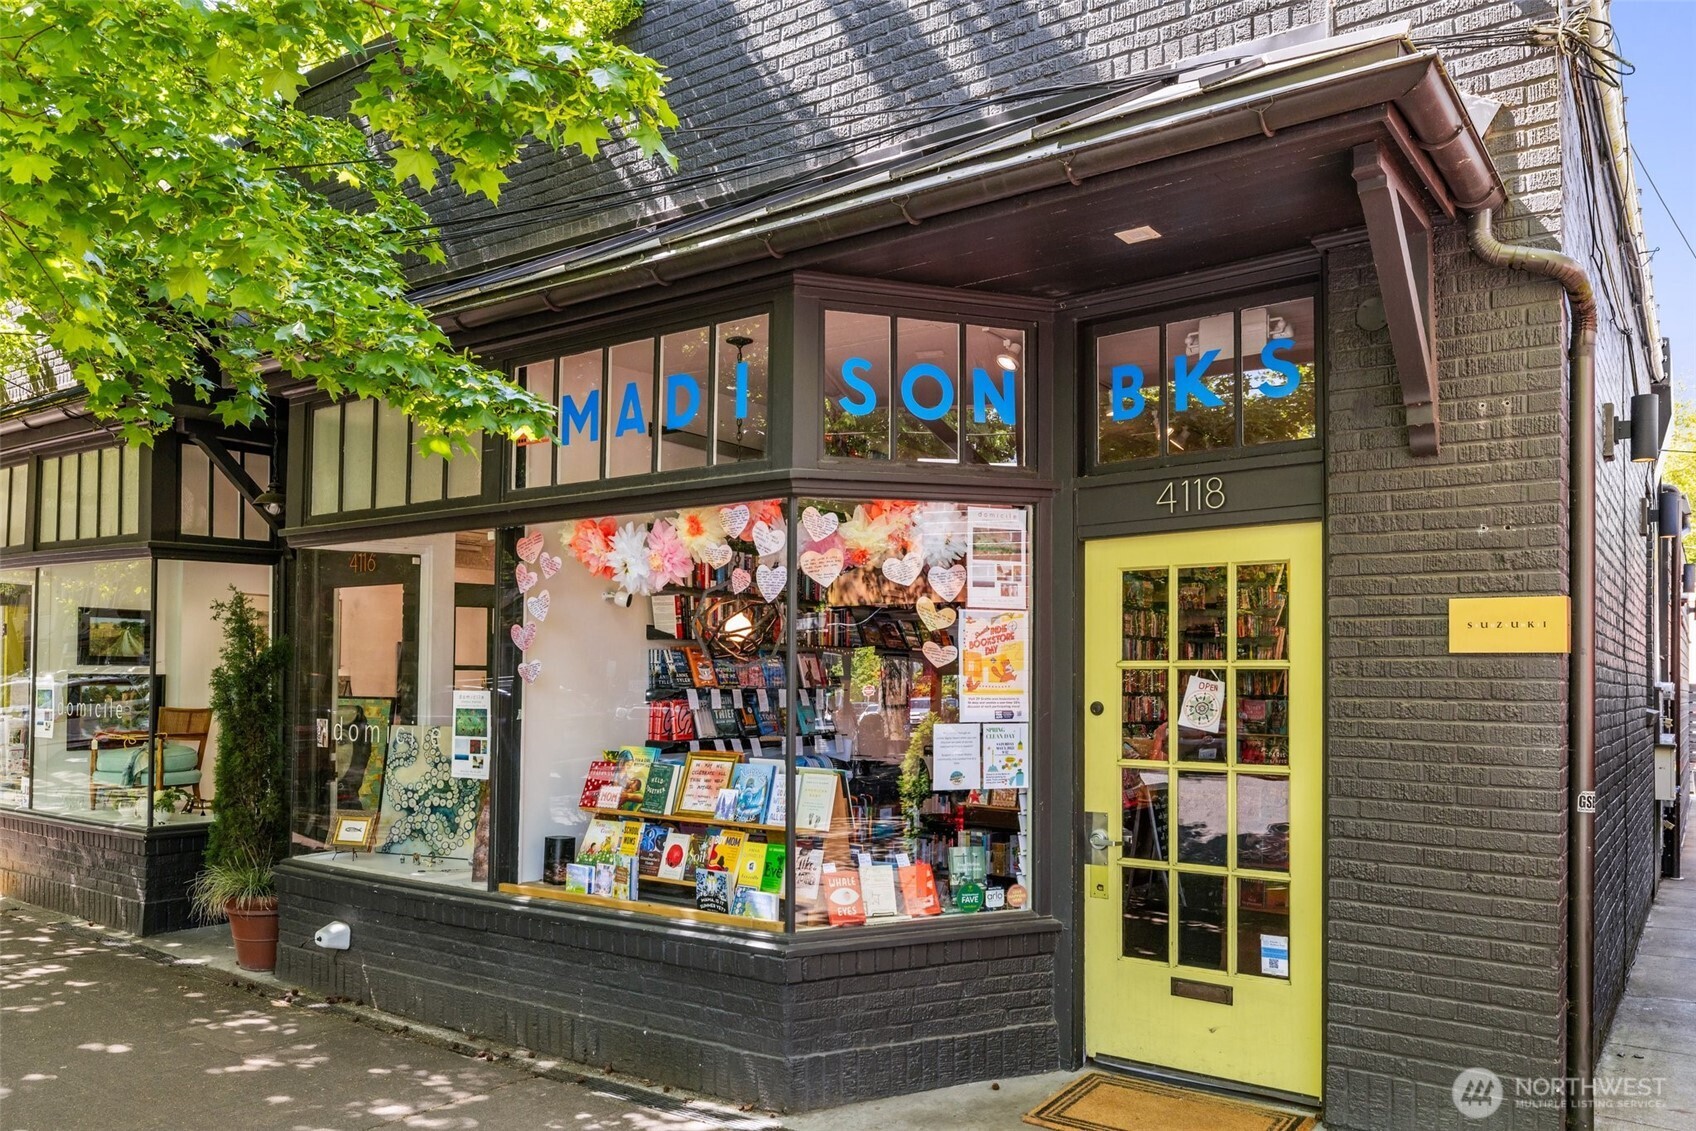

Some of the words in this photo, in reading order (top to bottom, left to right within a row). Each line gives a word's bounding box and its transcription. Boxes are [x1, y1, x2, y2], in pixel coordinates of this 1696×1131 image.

[1111, 339, 1301, 421] BKS
[1156, 477, 1226, 513] 4118
[349, 552, 377, 574] 4116
[989, 623, 1008, 636] INDIE
[968, 632, 1015, 650] BOOKSTORE
[984, 645, 999, 656] DAY
[1198, 681, 1219, 692] OPEN
[58, 697, 123, 719] domicile
[713, 708, 735, 720] THIEF
[333, 716, 441, 749] domicile
[600, 791, 618, 803] MOM
[623, 825, 640, 836] SCHOOL
[764, 861, 784, 879] Eve
[828, 876, 857, 888] WHALE
[961, 894, 980, 904] FAVE
[837, 906, 858, 917] EYES
